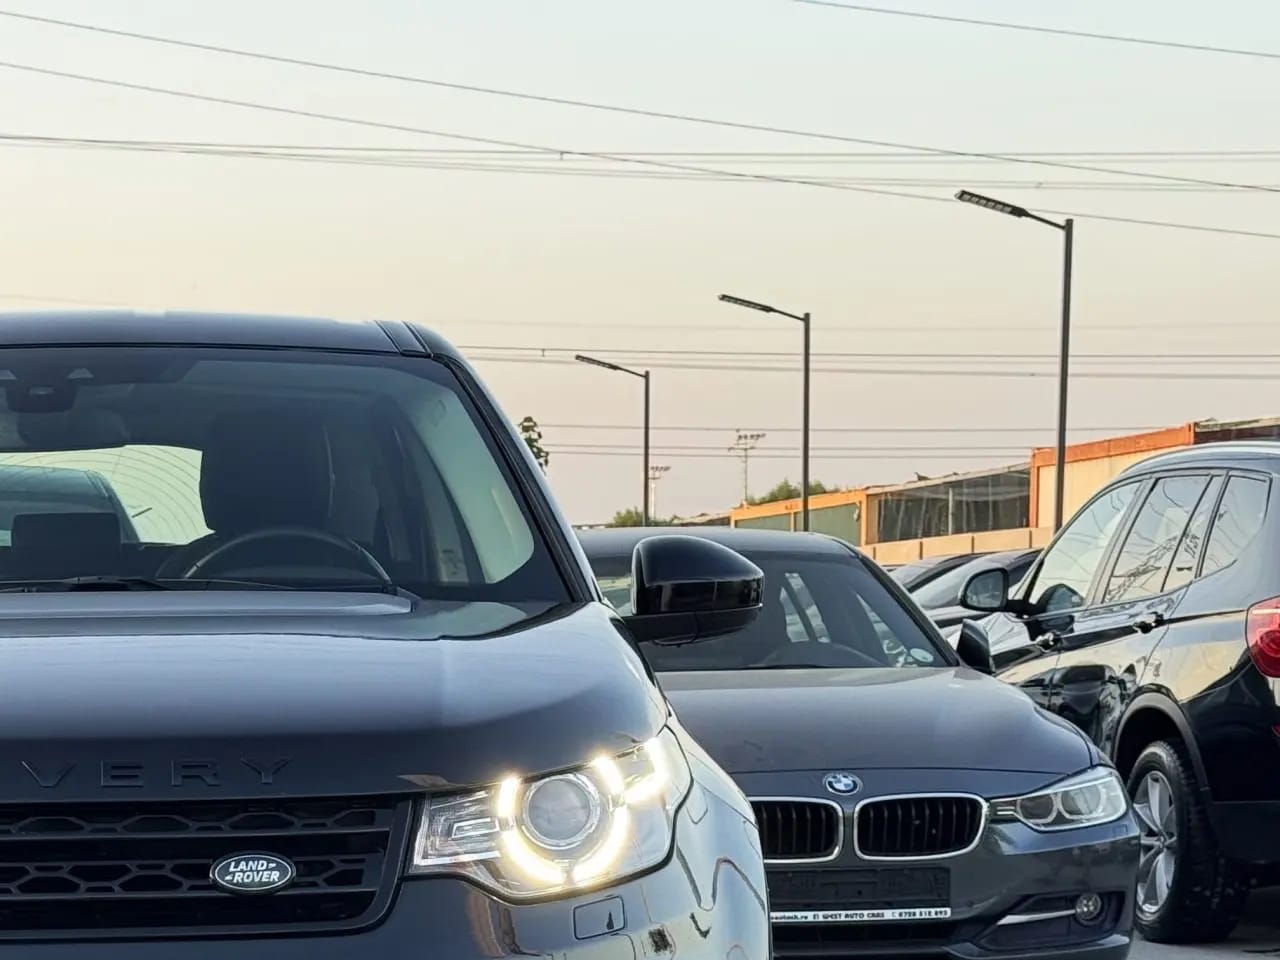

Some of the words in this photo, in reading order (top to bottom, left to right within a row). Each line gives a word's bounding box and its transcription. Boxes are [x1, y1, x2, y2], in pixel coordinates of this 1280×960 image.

[229, 860, 267, 872] LAND
[233, 870, 280, 883] ROVER
[845, 911, 865, 919] AUTO
